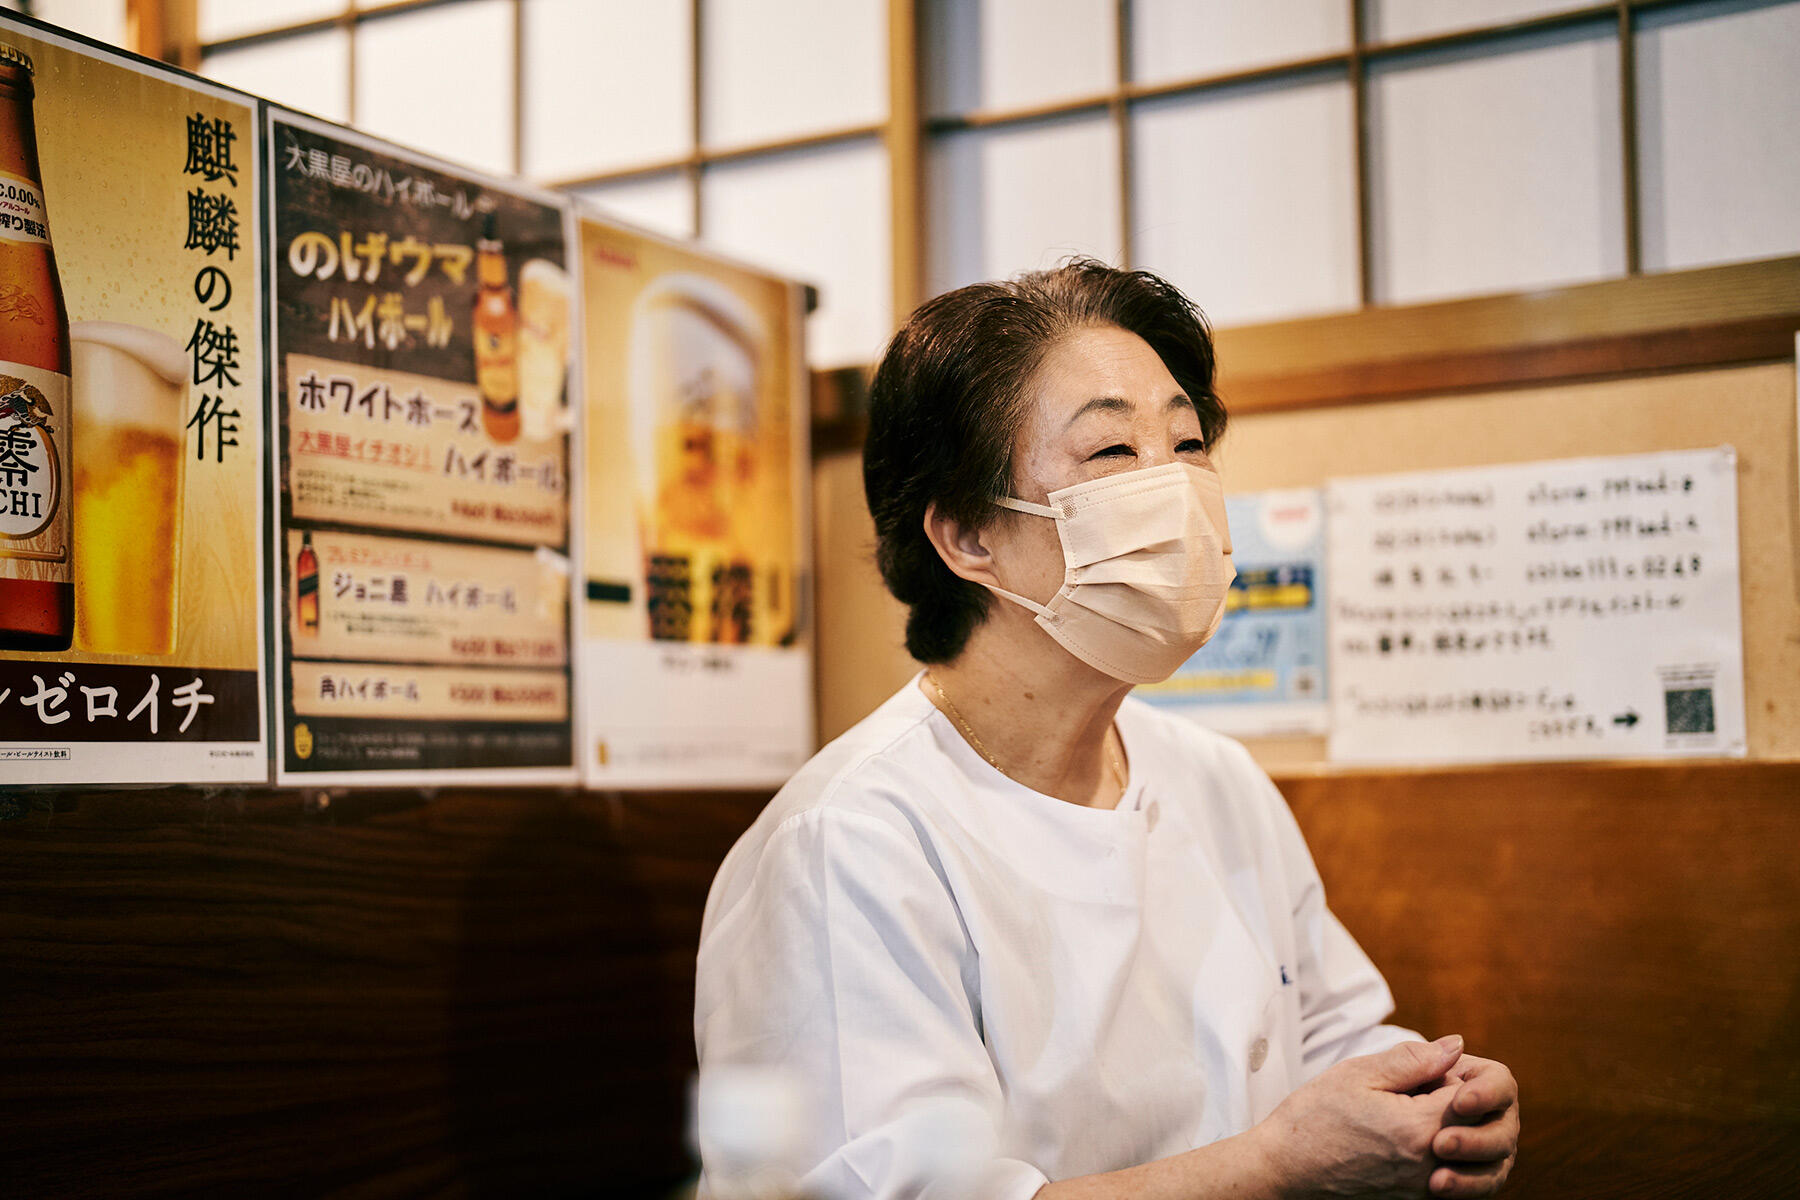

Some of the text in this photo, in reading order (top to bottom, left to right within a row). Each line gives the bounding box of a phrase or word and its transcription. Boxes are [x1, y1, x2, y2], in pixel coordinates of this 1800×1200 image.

[288, 231, 473, 287] のげウマ
[183, 112, 241, 464] 麒麟の傑作
[328, 293, 453, 350] ハイボール
[299, 373, 479, 433] ホワイトホース
[319, 675, 419, 702] 角ハイボール
